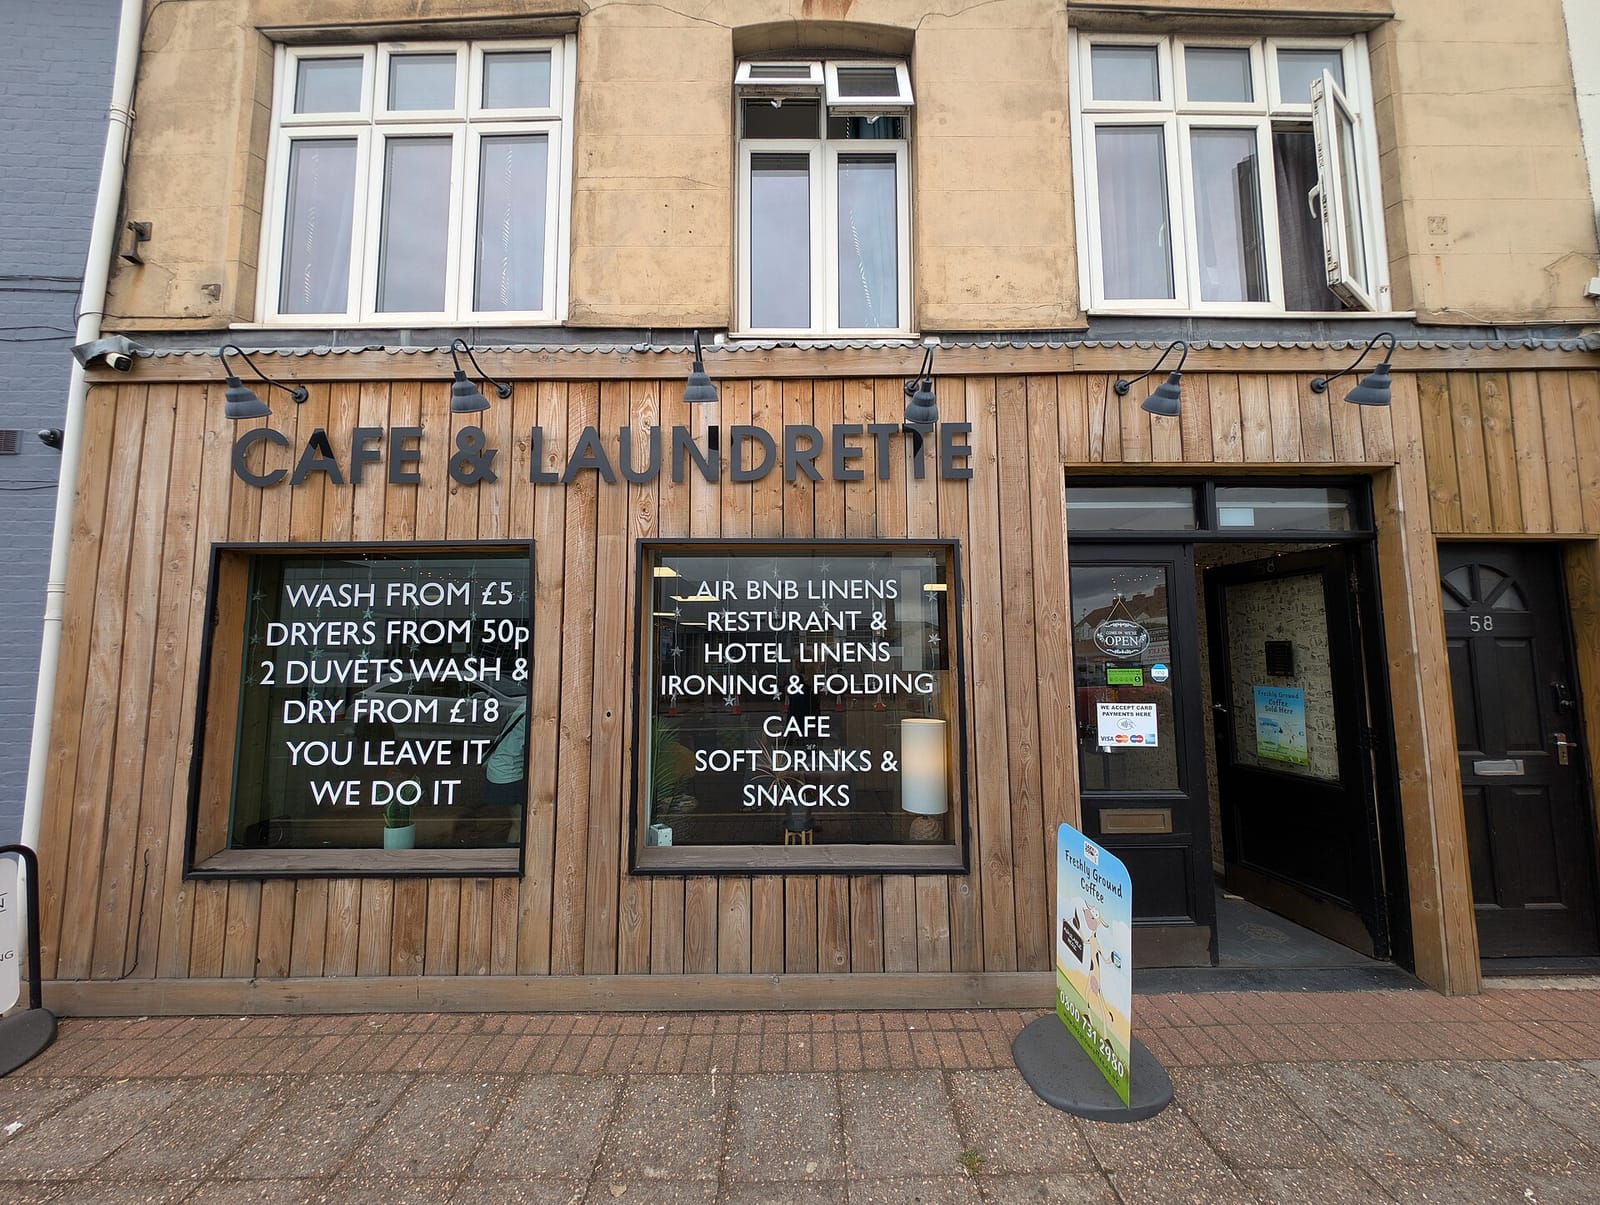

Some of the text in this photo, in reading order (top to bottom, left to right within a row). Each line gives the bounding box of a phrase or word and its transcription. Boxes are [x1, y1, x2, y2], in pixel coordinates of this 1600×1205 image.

[231, 422, 974, 488] CAFE & LAUNDRETTE
[286, 581, 513, 608] WASH FROM £5
[696, 579, 898, 600] AIR BNB LINENS
[707, 611, 887, 632] RESTURANT &
[1470, 615, 1493, 632] 58
[266, 619, 530, 650] DRYERS FROM 50p
[1105, 636, 1138, 646] OPEN
[704, 641, 891, 663] HOTEL LINENS
[259, 657, 529, 685] 2 DUVETS WASH &
[661, 673, 934, 696] IRONING & FOLDING
[283, 698, 499, 724] DRY FROM £18
[1268, 699, 1289, 707] Coffee
[763, 715, 831, 738] CAFE
[286, 739, 491, 766] YOU LEAVE IT
[695, 749, 898, 772] SOFT DRINKS &
[310, 779, 462, 806] WE DO IT
[743, 784, 850, 807] SNACKS
[1064, 849, 1091, 880] Freshly
[1092, 868, 1122, 898] Ground
[1080, 877, 1105, 904] Coffee
[1060, 990, 1124, 1078] 0800 731 2980
